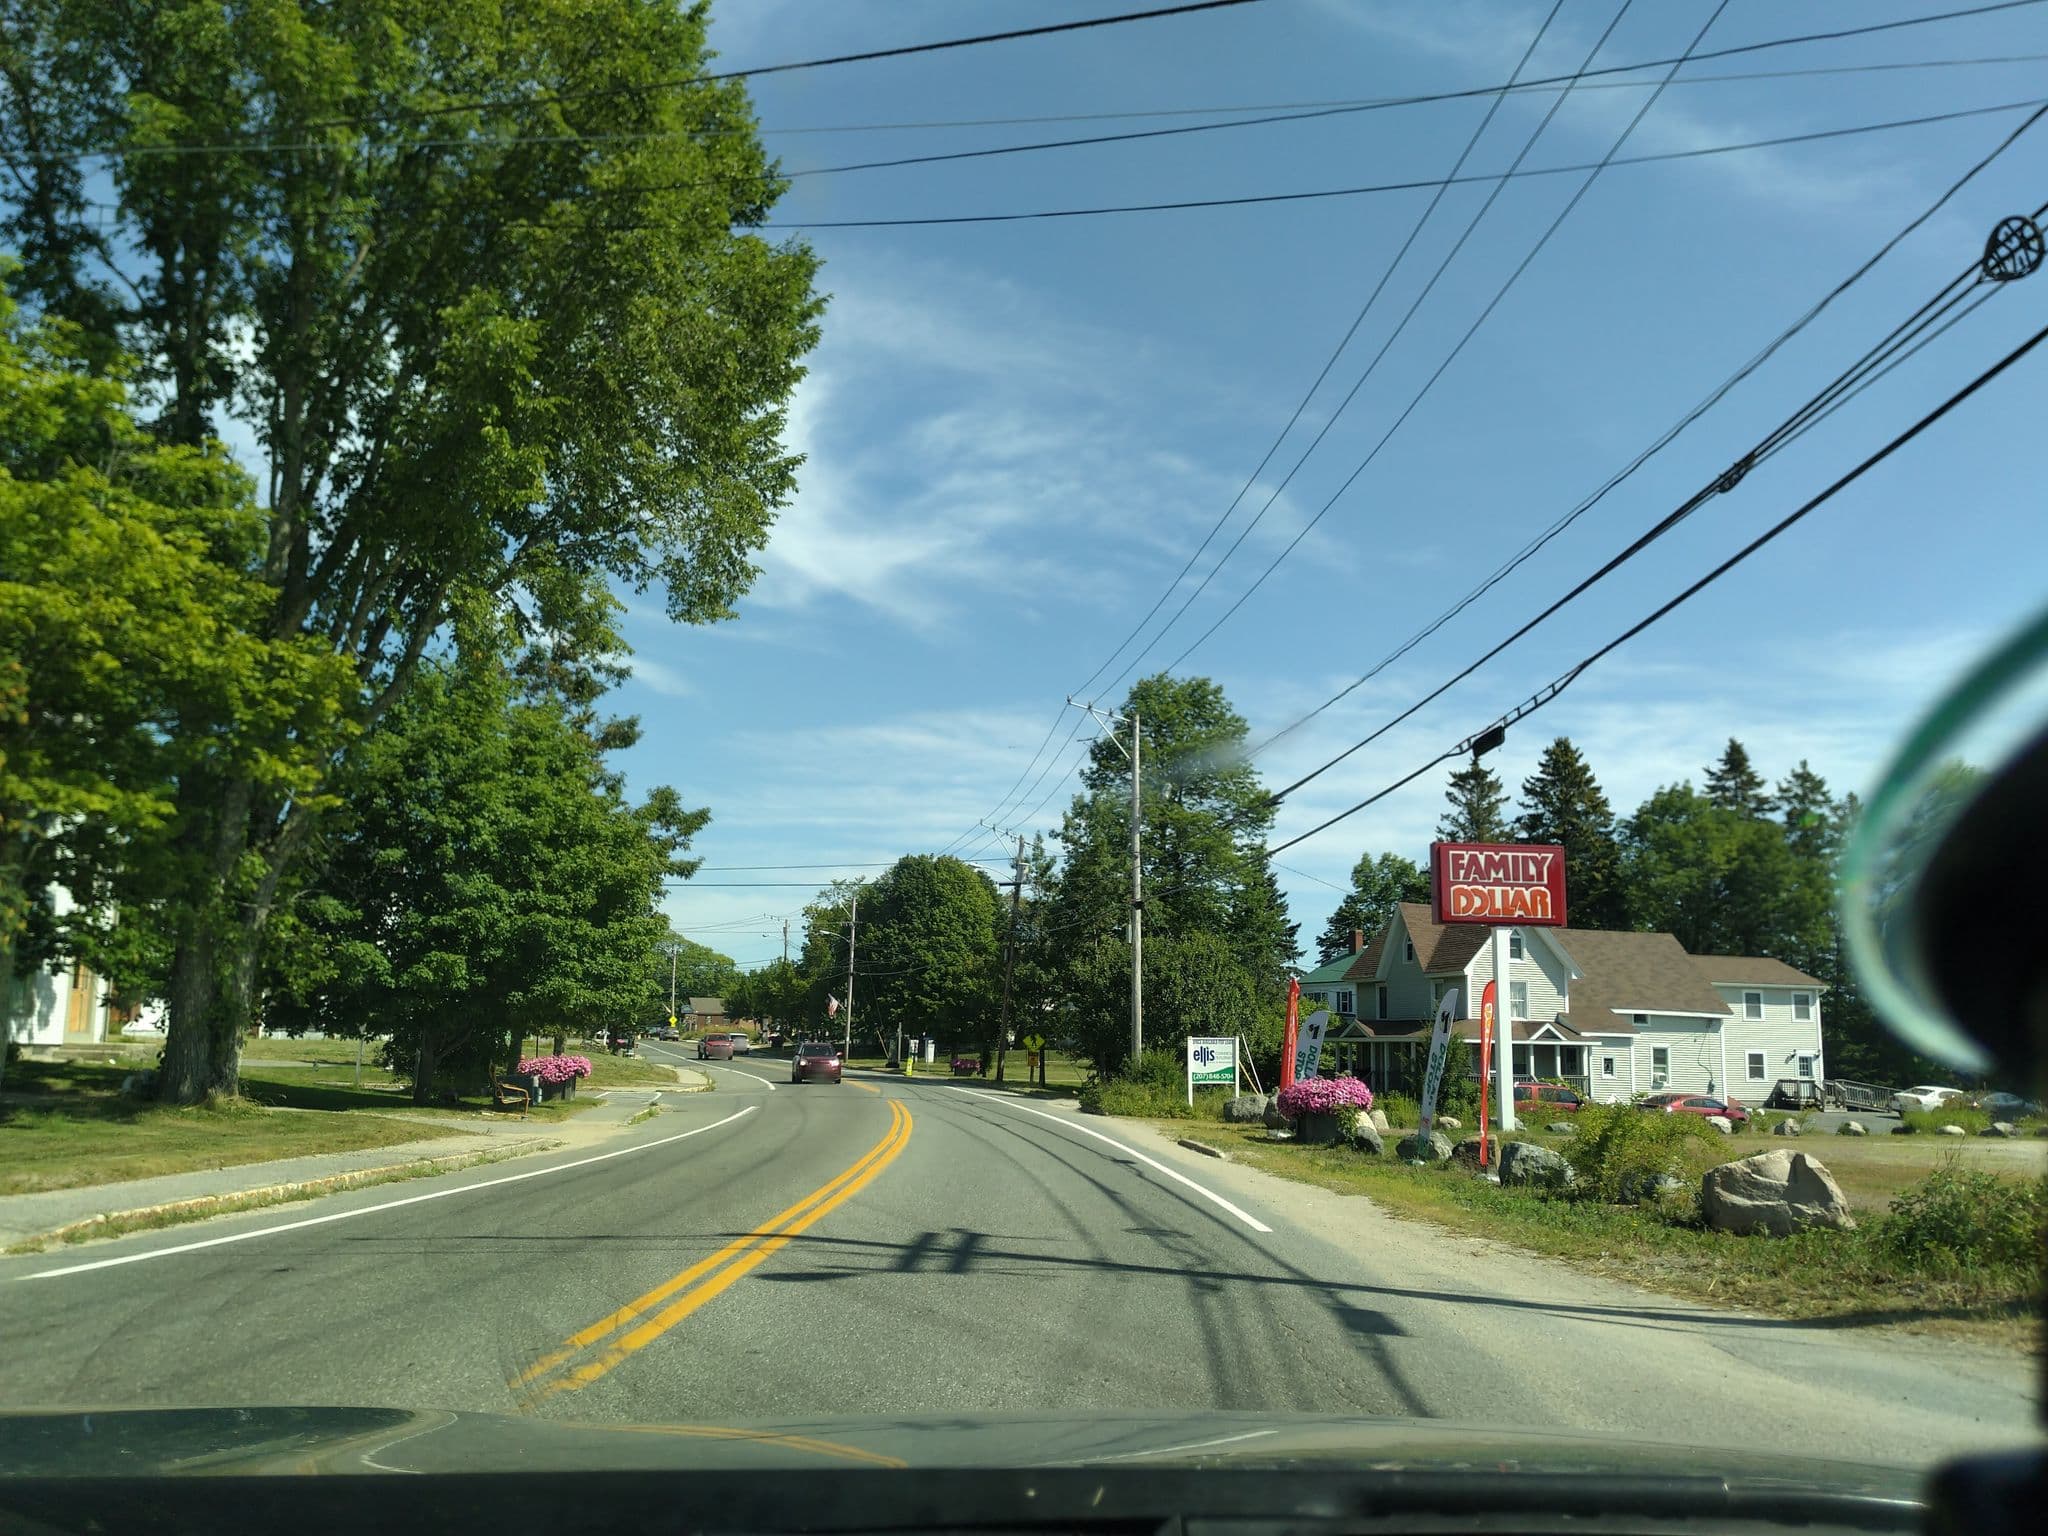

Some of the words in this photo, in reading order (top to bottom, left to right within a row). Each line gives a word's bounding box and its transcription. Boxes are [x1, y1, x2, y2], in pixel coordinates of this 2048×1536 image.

[1449, 851, 1554, 884] FAMILY
[1450, 885, 1552, 918] DOLLAR
[1193, 1046, 1215, 1067] ellis
[1305, 1045, 1318, 1079] DOLLA
